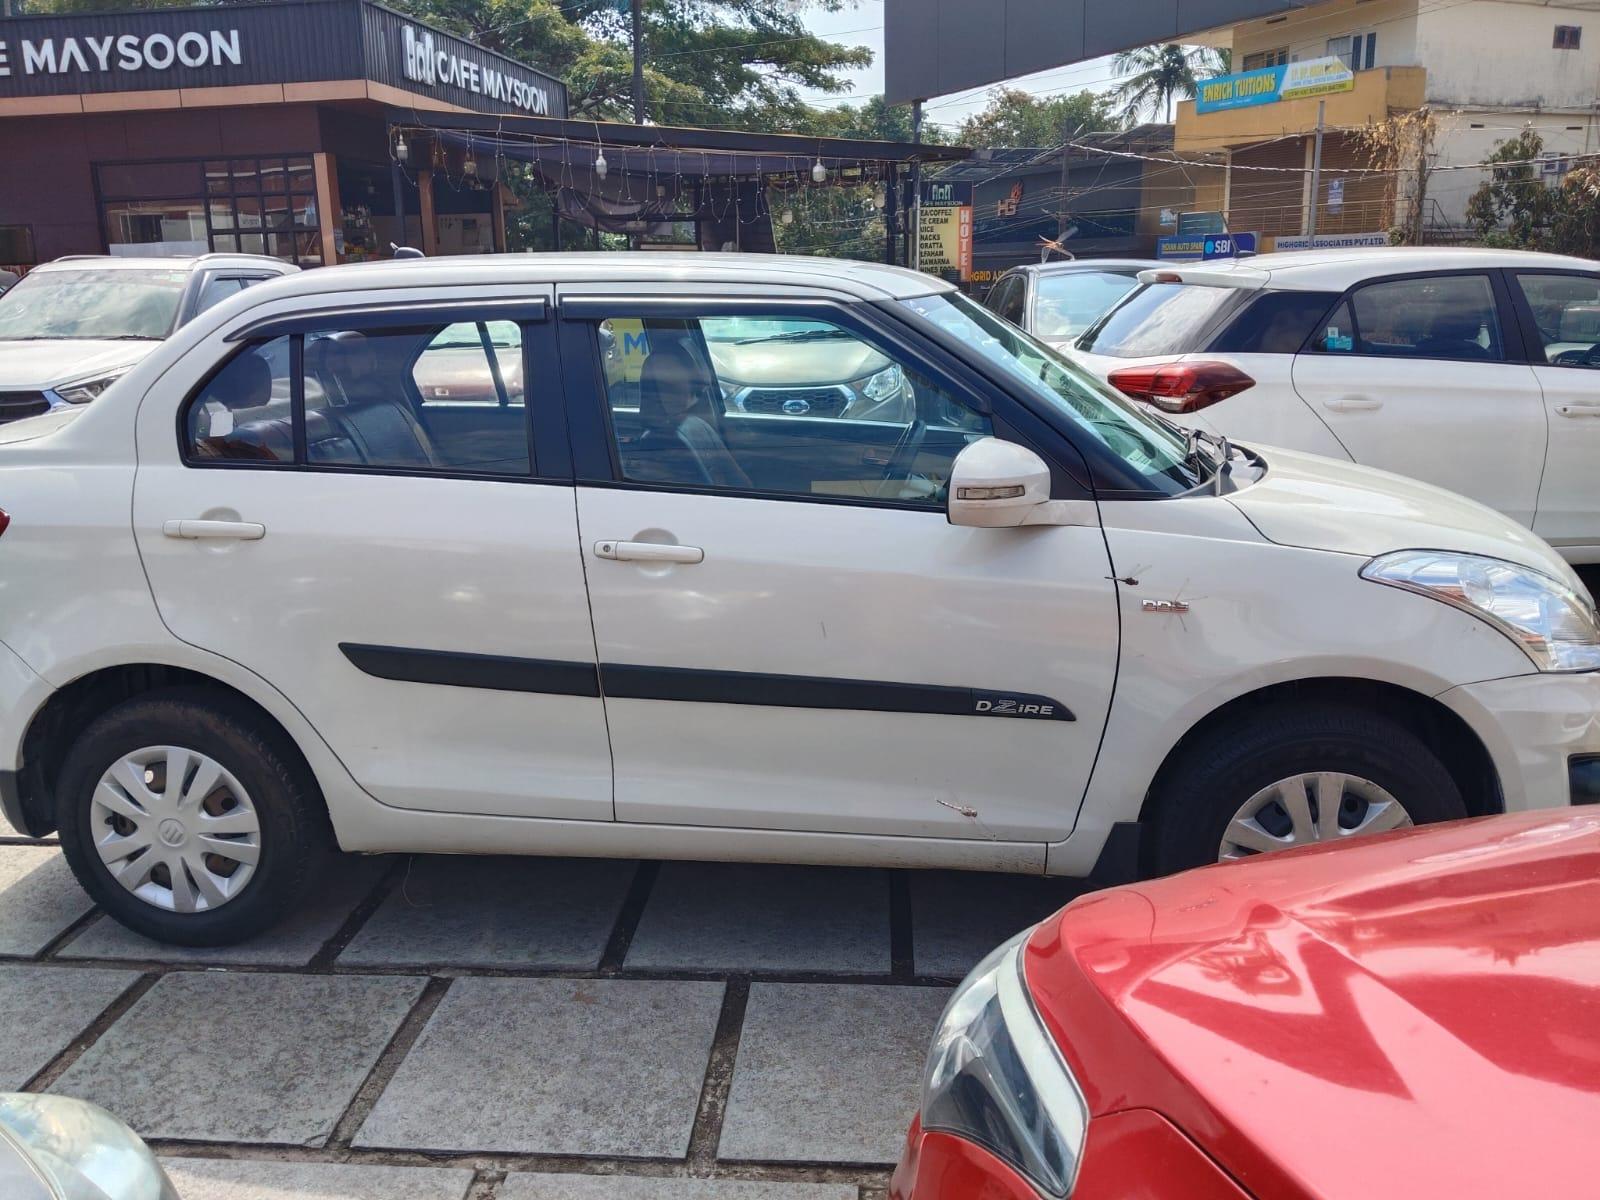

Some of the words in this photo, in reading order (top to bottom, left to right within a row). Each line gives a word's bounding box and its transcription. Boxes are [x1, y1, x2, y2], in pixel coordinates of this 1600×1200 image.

[21, 29, 242, 75] MAYSOON
[436, 50, 481, 93] CAFE
[483, 66, 548, 116] MAYSOON
[1203, 80, 1233, 103] ENRICH
[1234, 73, 1276, 97] TUITIONS
[1214, 240, 1230, 253] SBI
